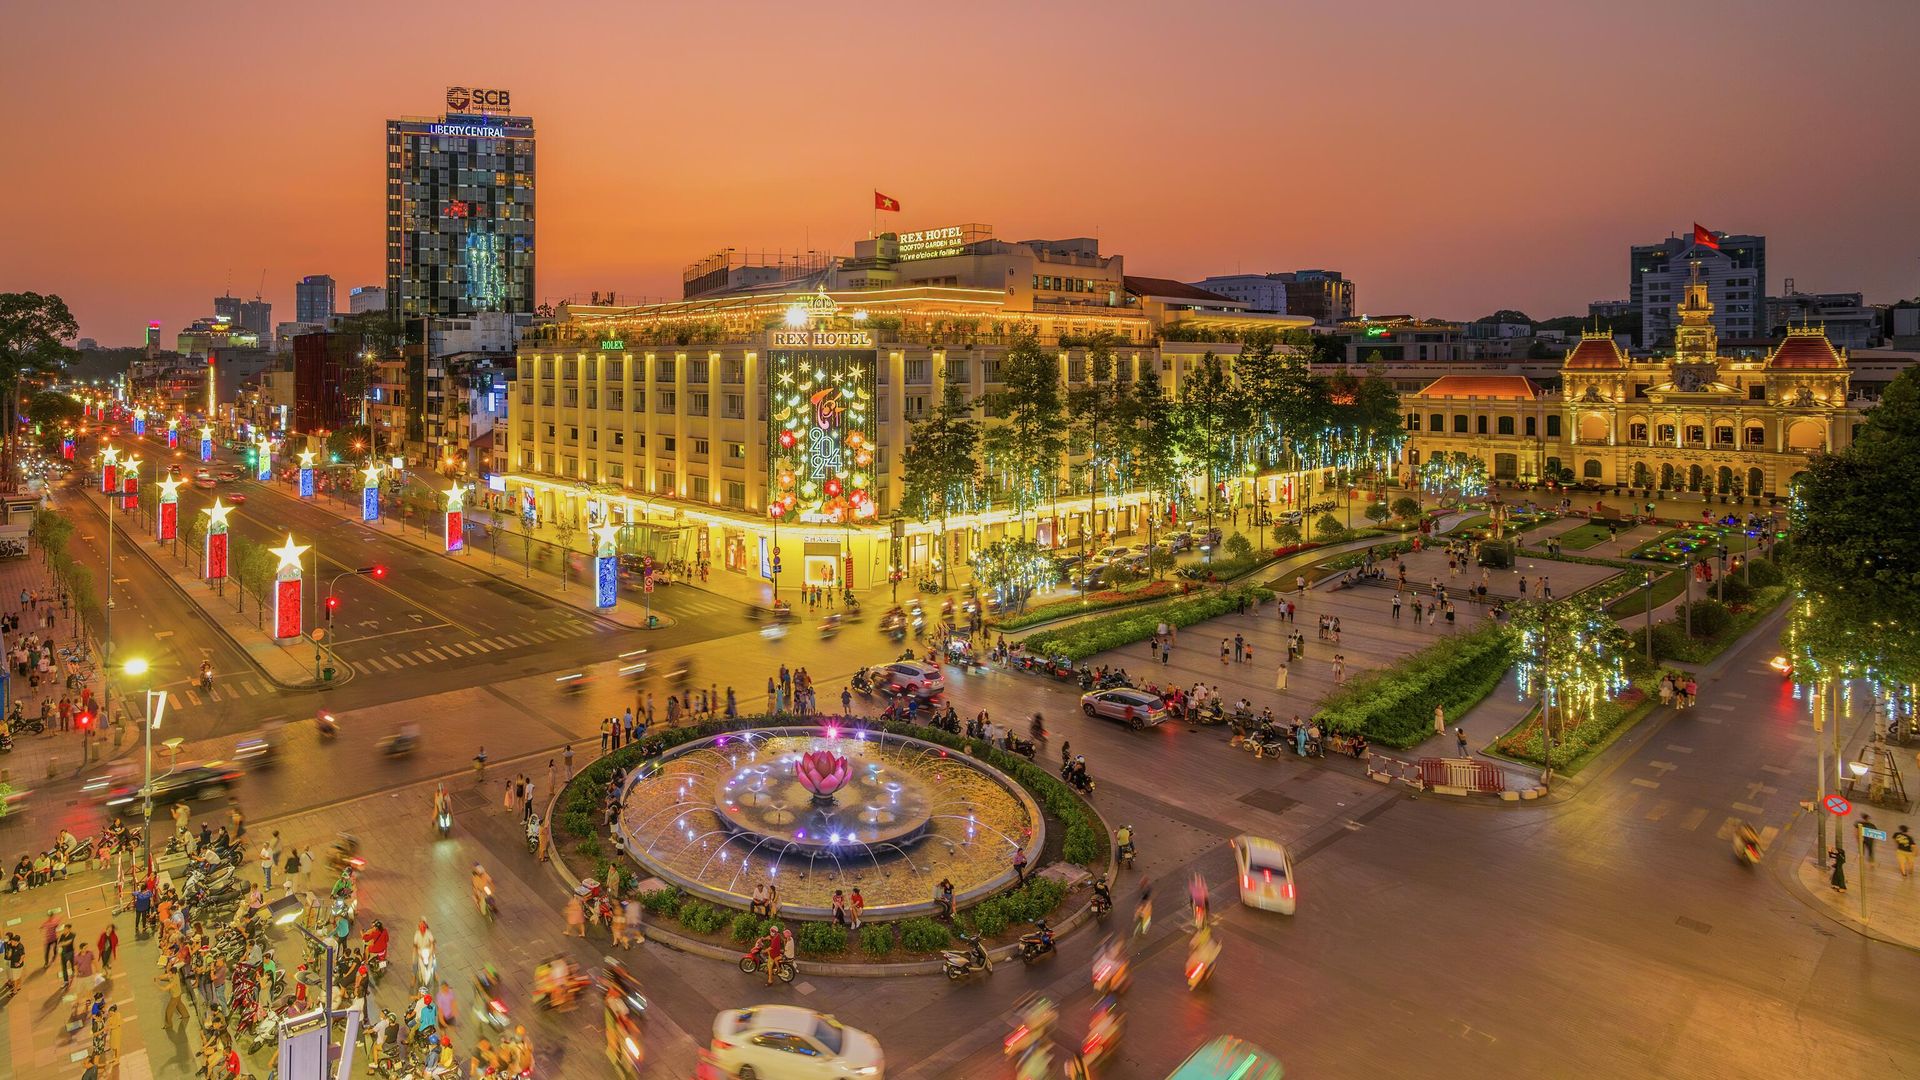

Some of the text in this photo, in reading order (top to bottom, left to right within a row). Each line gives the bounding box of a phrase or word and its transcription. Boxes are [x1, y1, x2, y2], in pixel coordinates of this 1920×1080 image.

[472, 89, 510, 106] SCB
[430, 124, 505, 138] LIBERTY CENTRAL
[900, 227, 963, 244] REX HOTEL
[899, 238, 962, 252] ROOFTOP GARDEN BAR
[602, 340, 624, 350] ROLEX
[774, 332, 871, 345] REX HOTEL
[803, 535, 841, 543] CHANEL
